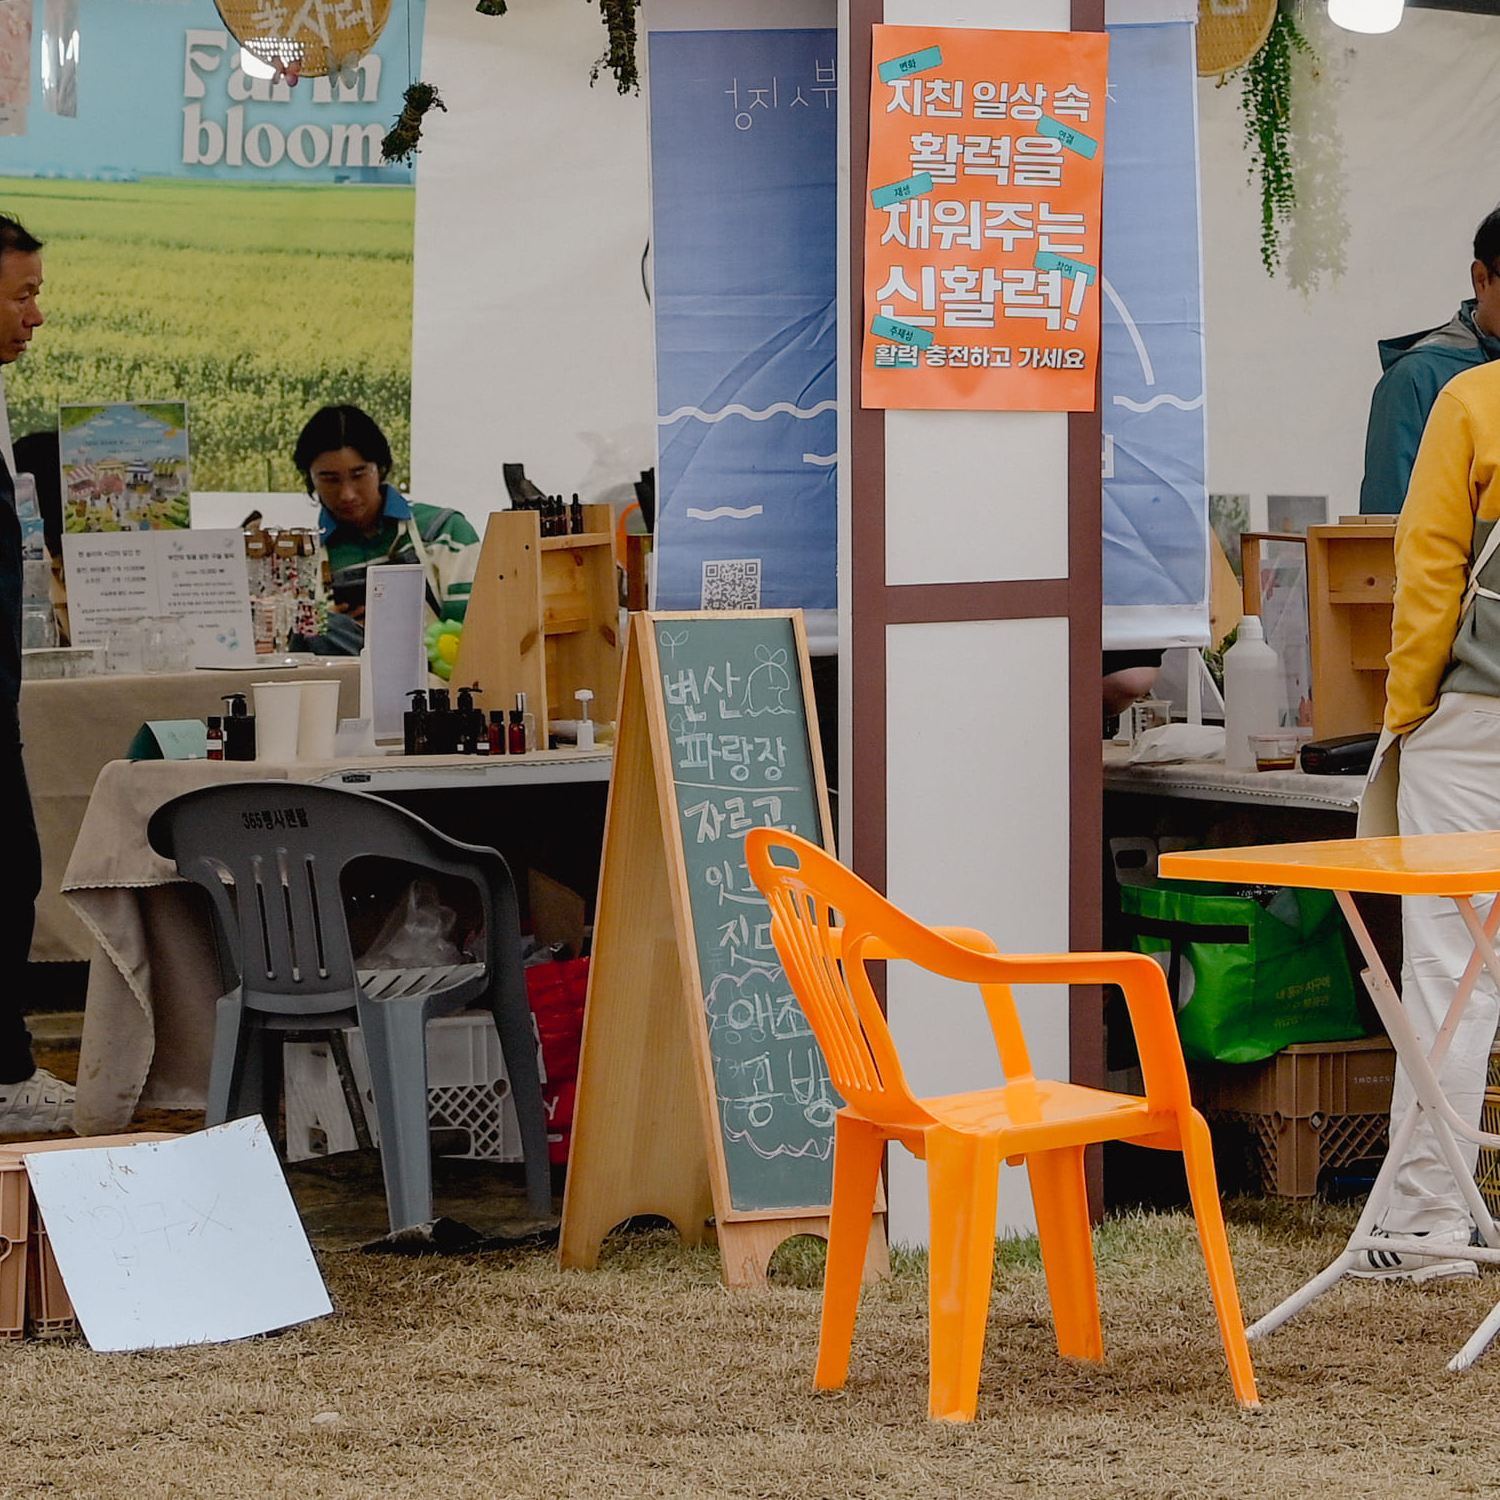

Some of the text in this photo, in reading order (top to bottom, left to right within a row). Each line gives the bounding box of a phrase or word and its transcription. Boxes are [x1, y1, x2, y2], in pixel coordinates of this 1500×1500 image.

[885, 77, 1091, 123] 지친 일상 속
[182, 102, 389, 169] bloom
[908, 131, 1065, 188] 활력을
[880, 198, 1087, 254] 재워주는
[876, 264, 1089, 332] 신활력!
[874, 343, 1085, 369] 활력 충전하고 가세요
[663, 659, 743, 722] 변산
[675, 731, 788, 781] 파랑장
